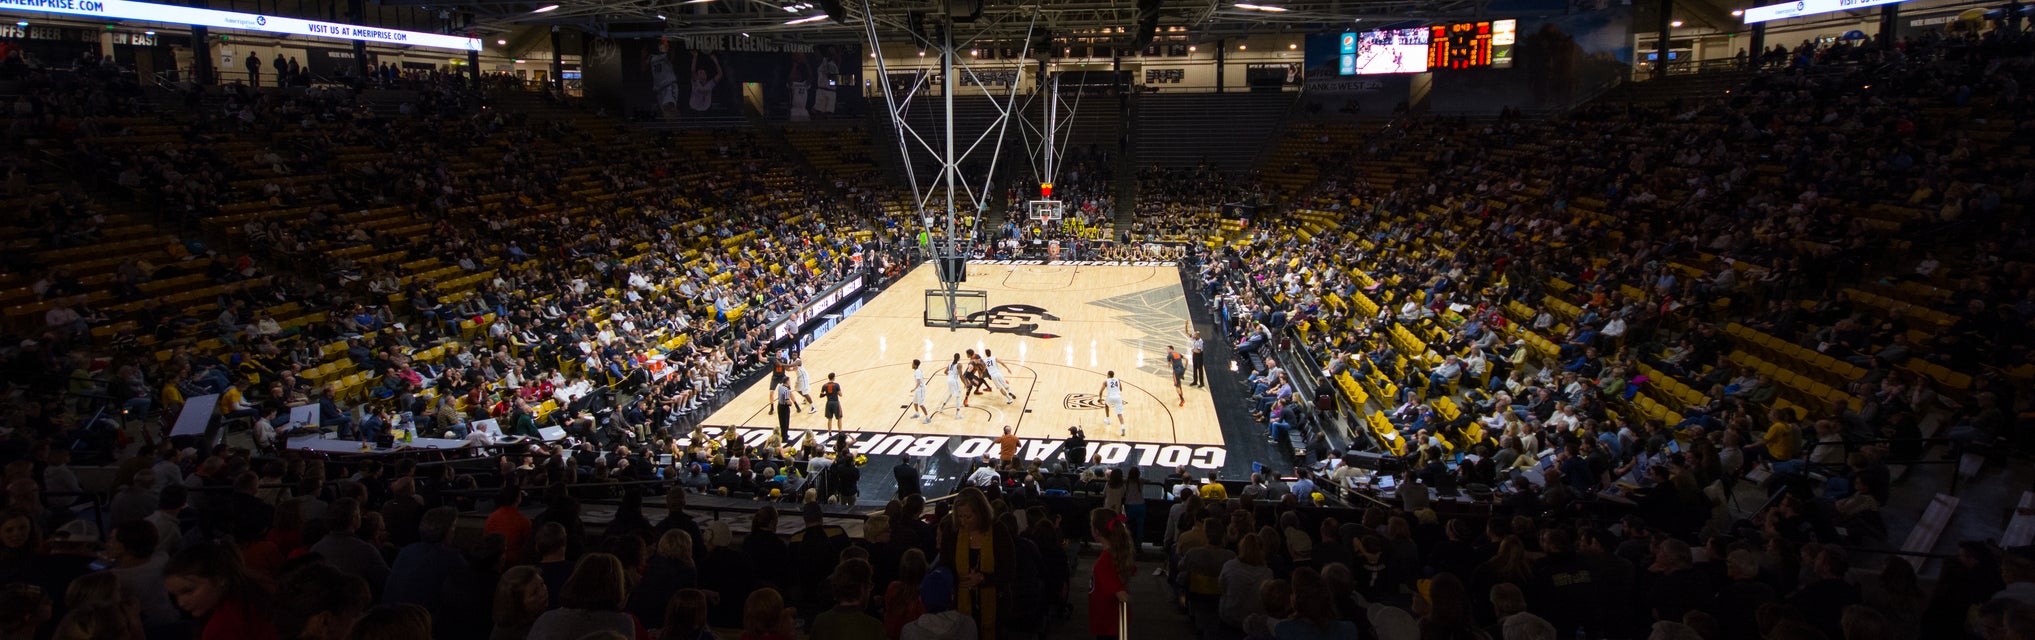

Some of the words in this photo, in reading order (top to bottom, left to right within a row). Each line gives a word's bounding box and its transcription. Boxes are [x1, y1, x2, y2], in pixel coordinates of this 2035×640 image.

[0, 26, 26, 39] FFS
[31, 27, 61, 40] BEER
[82, 31, 127, 44] GAEN
[132, 33, 159, 46] EAST
[308, 24, 327, 33] VISIT
[330, 26, 340, 34] US
[342, 27, 350, 35] AT
[353, 28, 407, 41] AMERIPRISE.COM
[685, 35, 725, 52] WHERE
[1338, 81, 1366, 90] WEST
